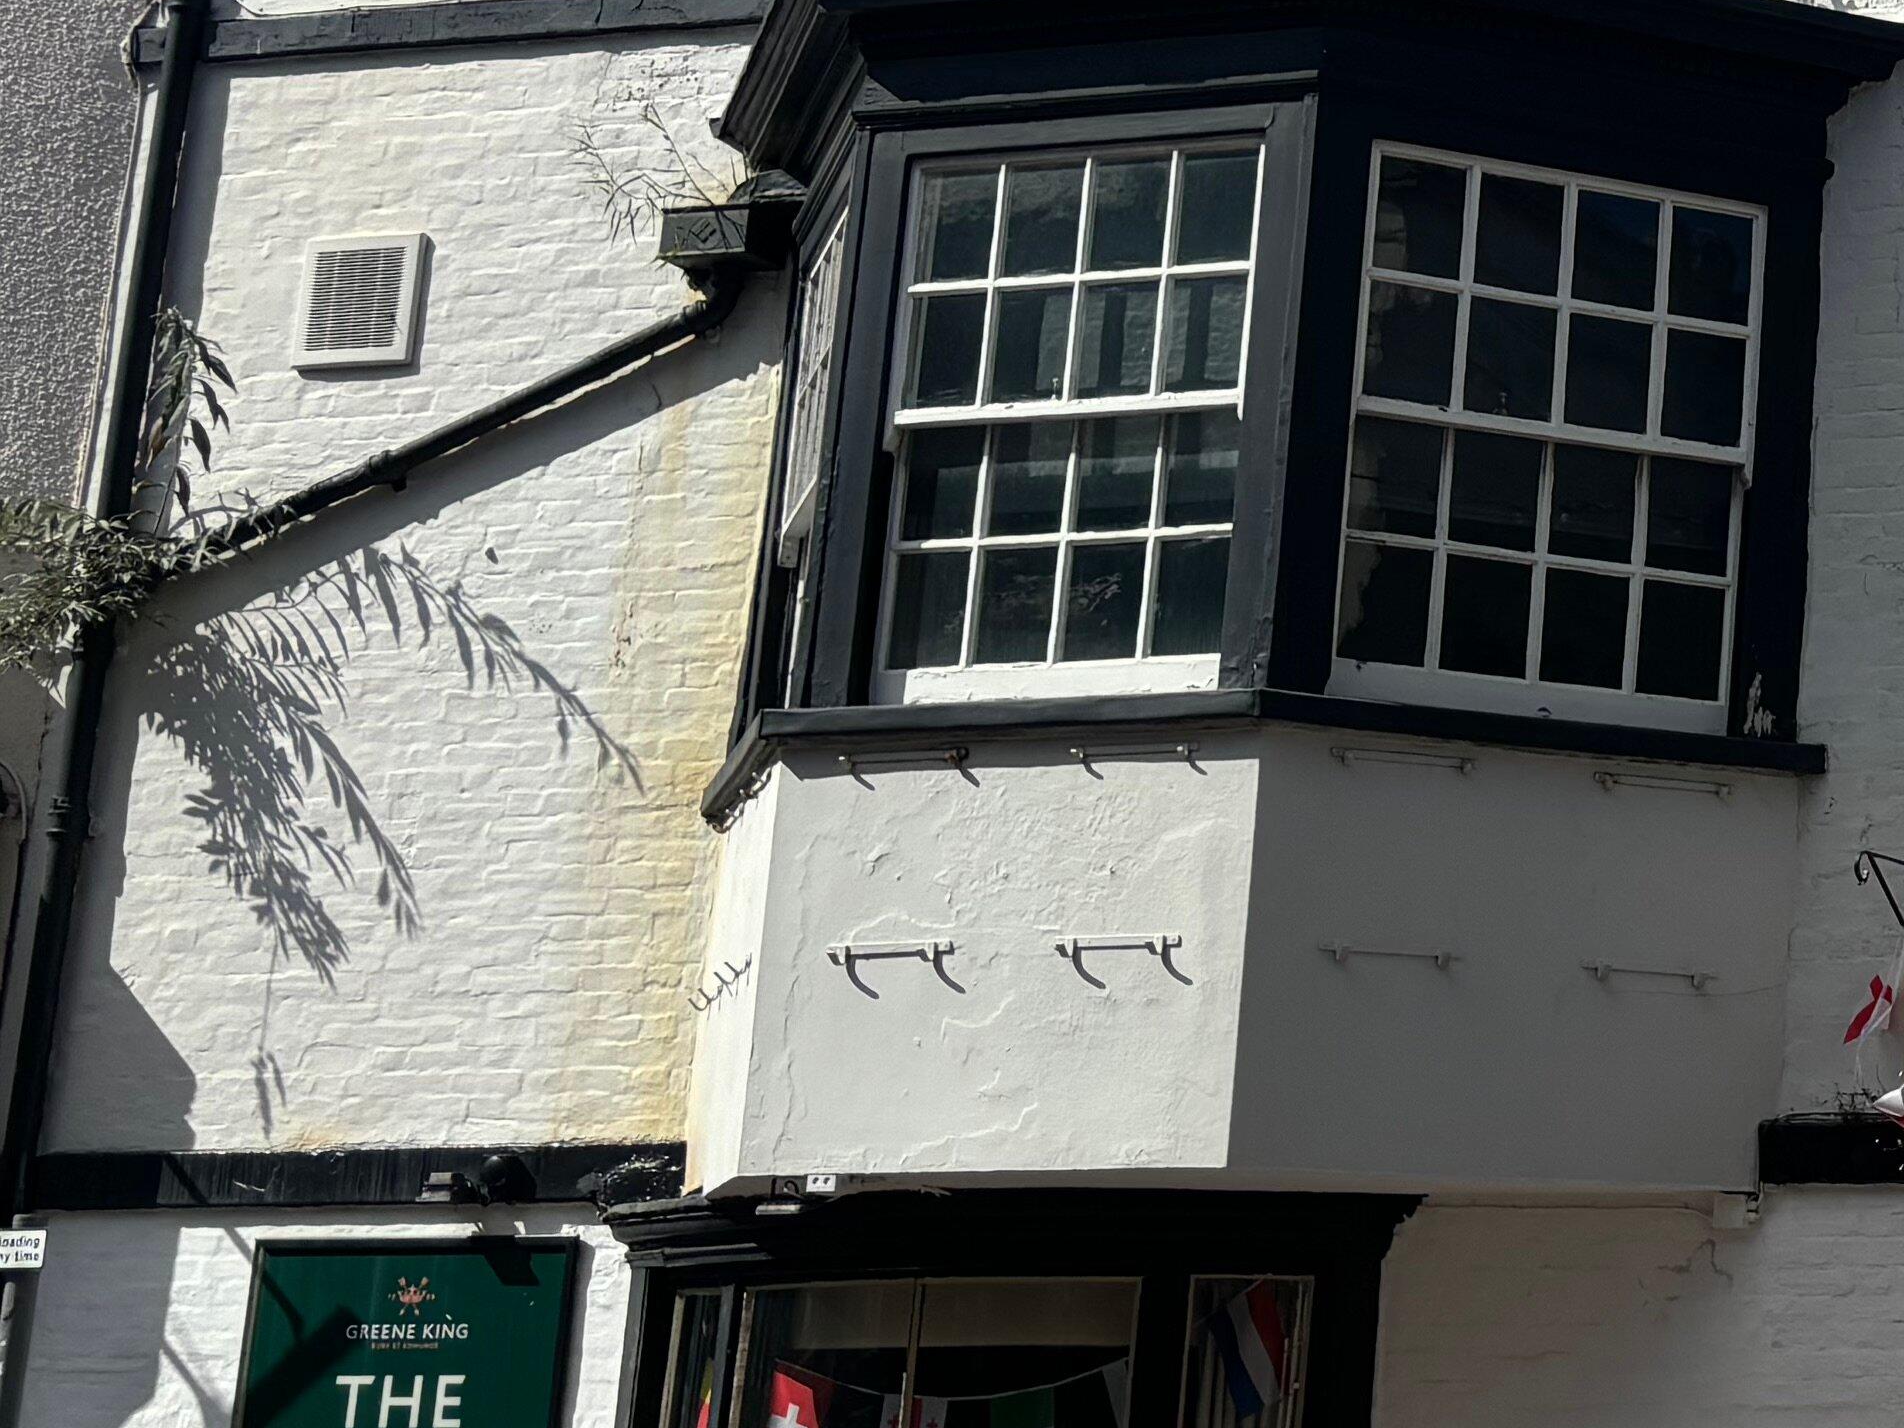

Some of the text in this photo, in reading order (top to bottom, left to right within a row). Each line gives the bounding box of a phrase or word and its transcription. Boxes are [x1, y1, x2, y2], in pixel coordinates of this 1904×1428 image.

[346, 1323, 469, 1340] GREENE KING
[335, 1374, 466, 1428] THE
